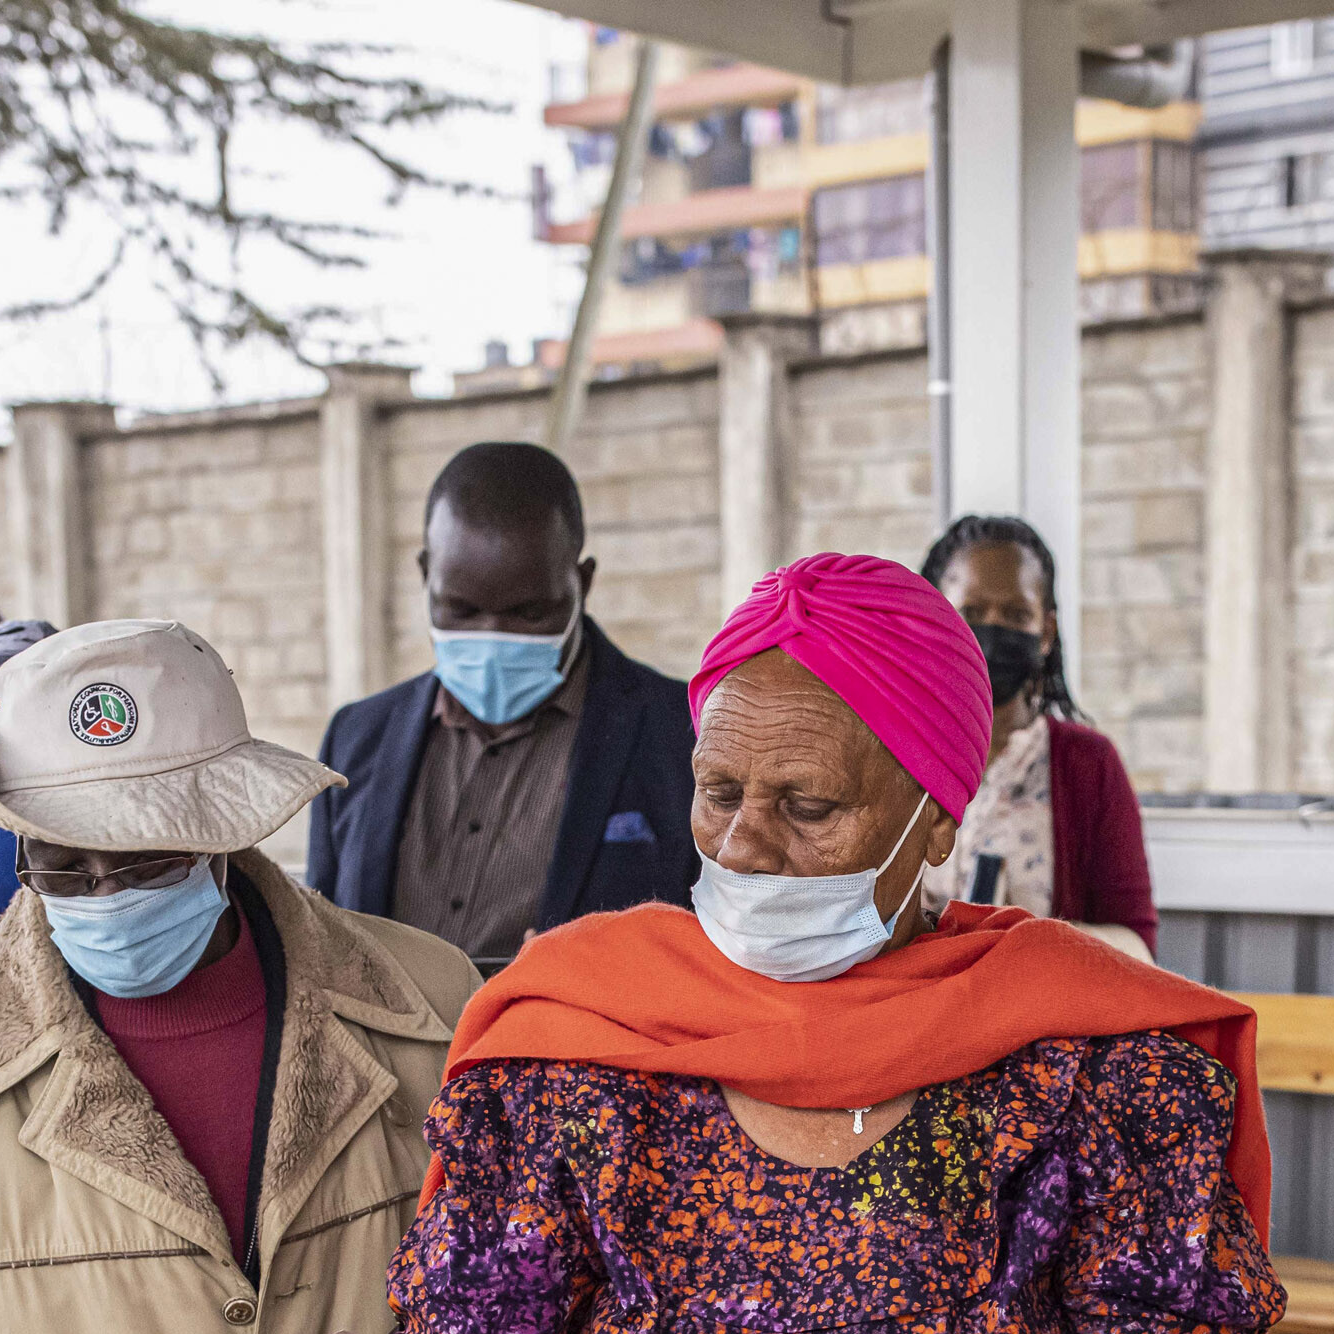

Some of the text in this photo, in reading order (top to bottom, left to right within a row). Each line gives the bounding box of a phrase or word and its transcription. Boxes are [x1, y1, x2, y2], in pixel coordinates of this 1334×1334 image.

[80, 686, 108, 700] COUNCIL
[109, 687, 121, 698] FOR
[72, 700, 83, 732] NATIONAL
[120, 694, 135, 724] PERSONS
[120, 725, 133, 739] WITH
